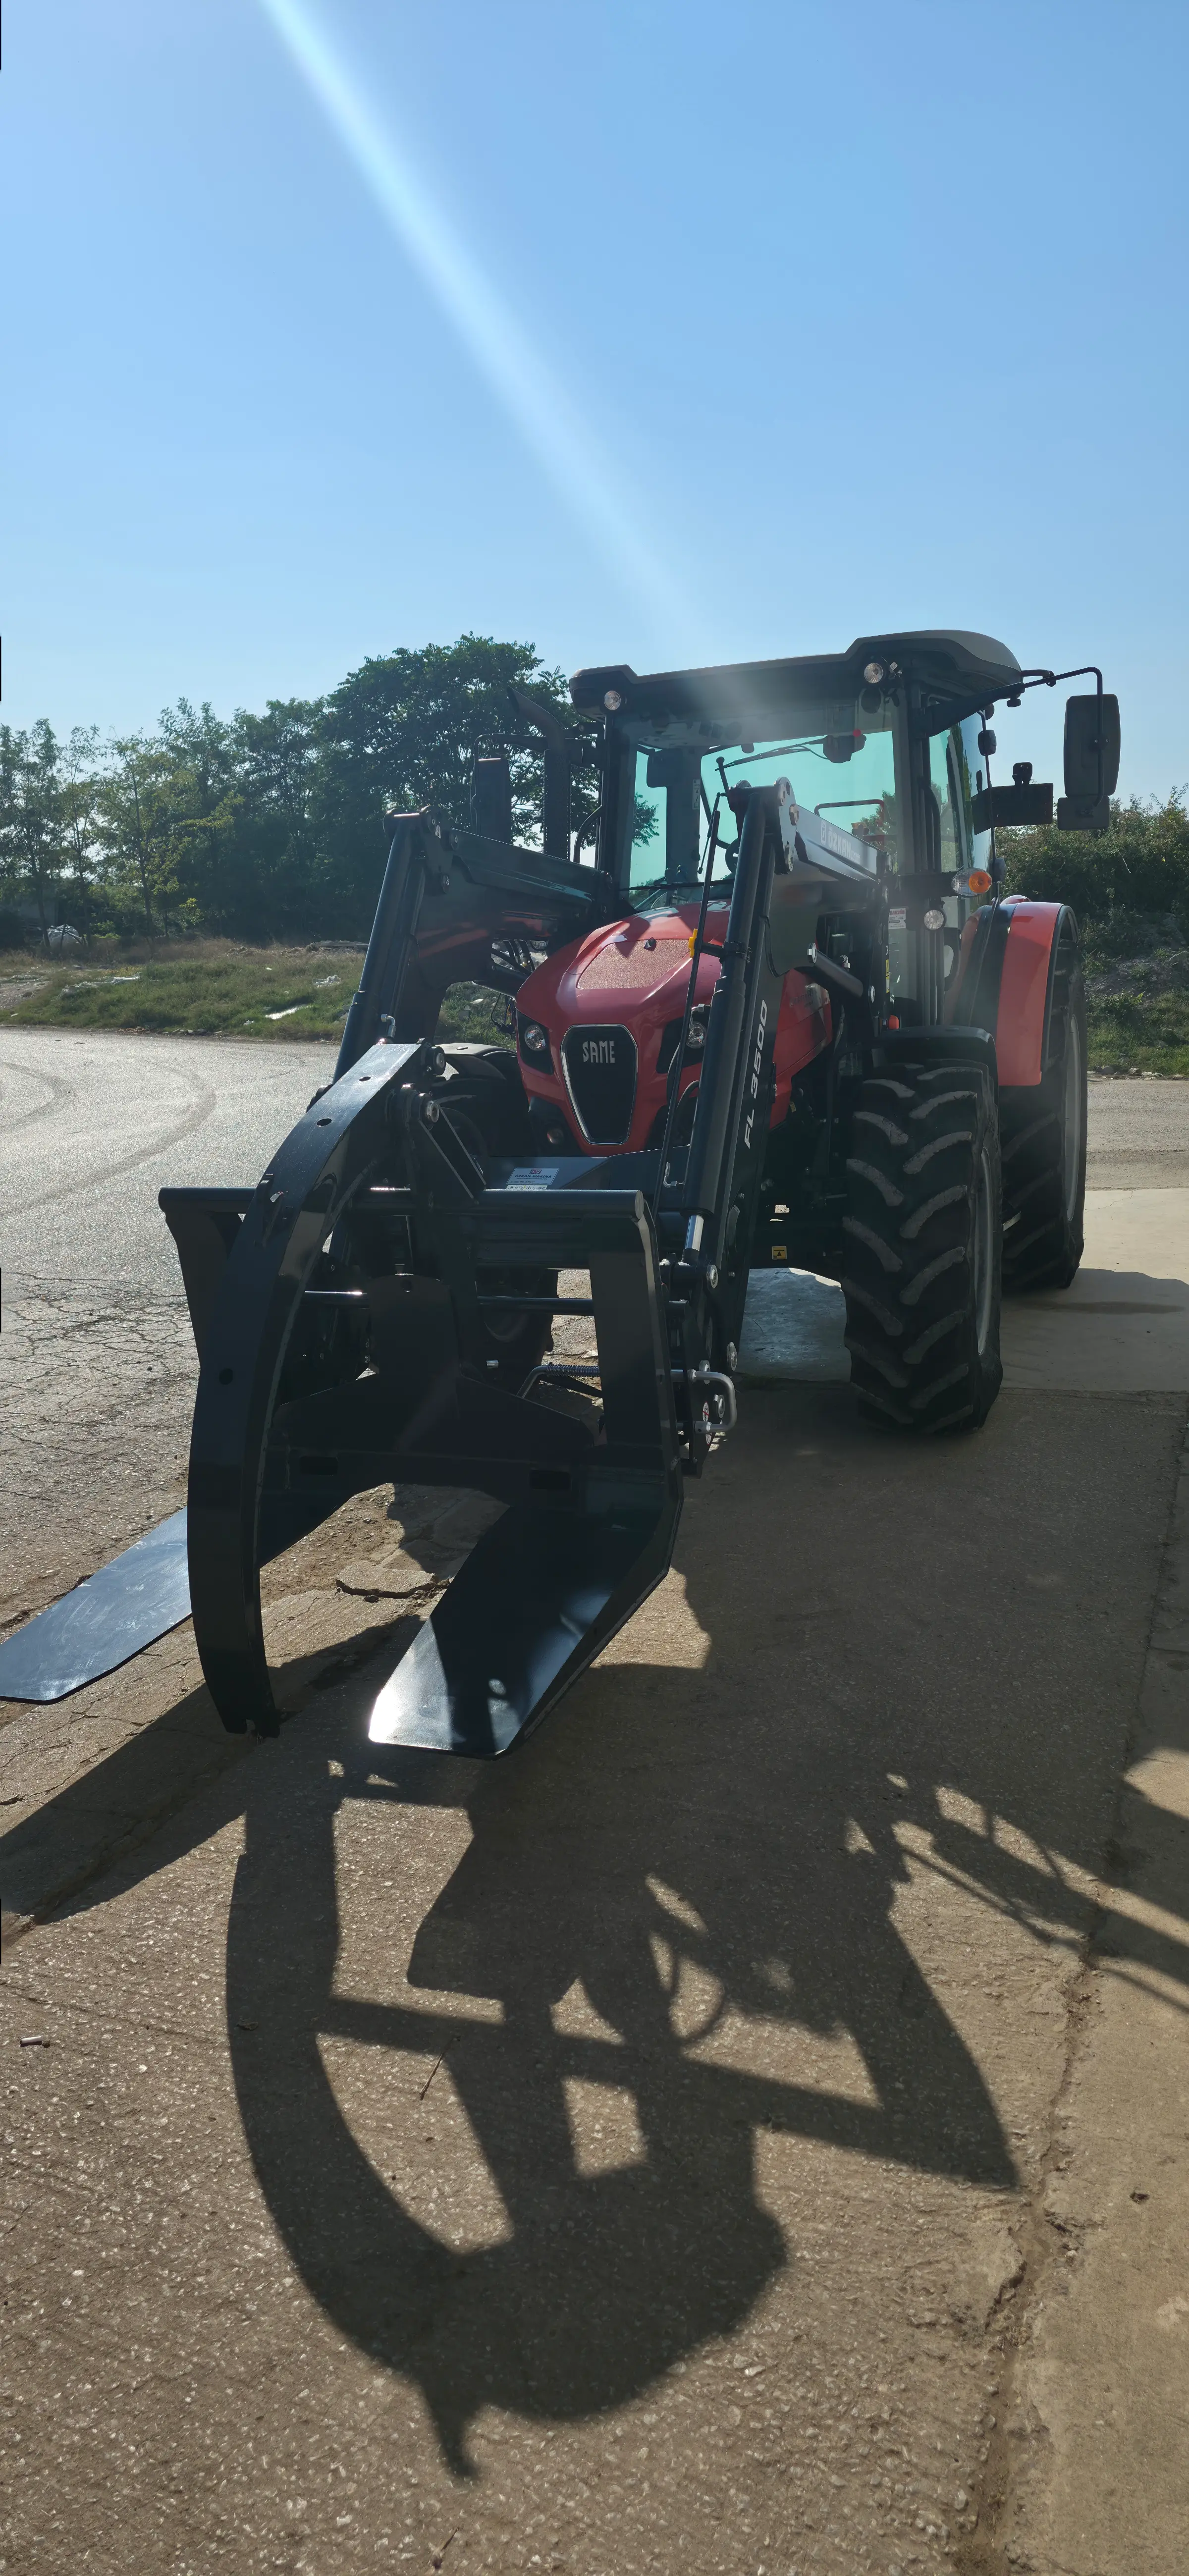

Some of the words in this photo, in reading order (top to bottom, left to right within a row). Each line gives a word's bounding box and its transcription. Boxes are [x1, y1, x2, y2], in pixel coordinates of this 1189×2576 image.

[828, 826, 851, 859] ÖZKAN
[582, 1040, 616, 1063] SAME
[744, 1109, 755, 1149] FL
[751, 1000, 767, 1099] 3500
